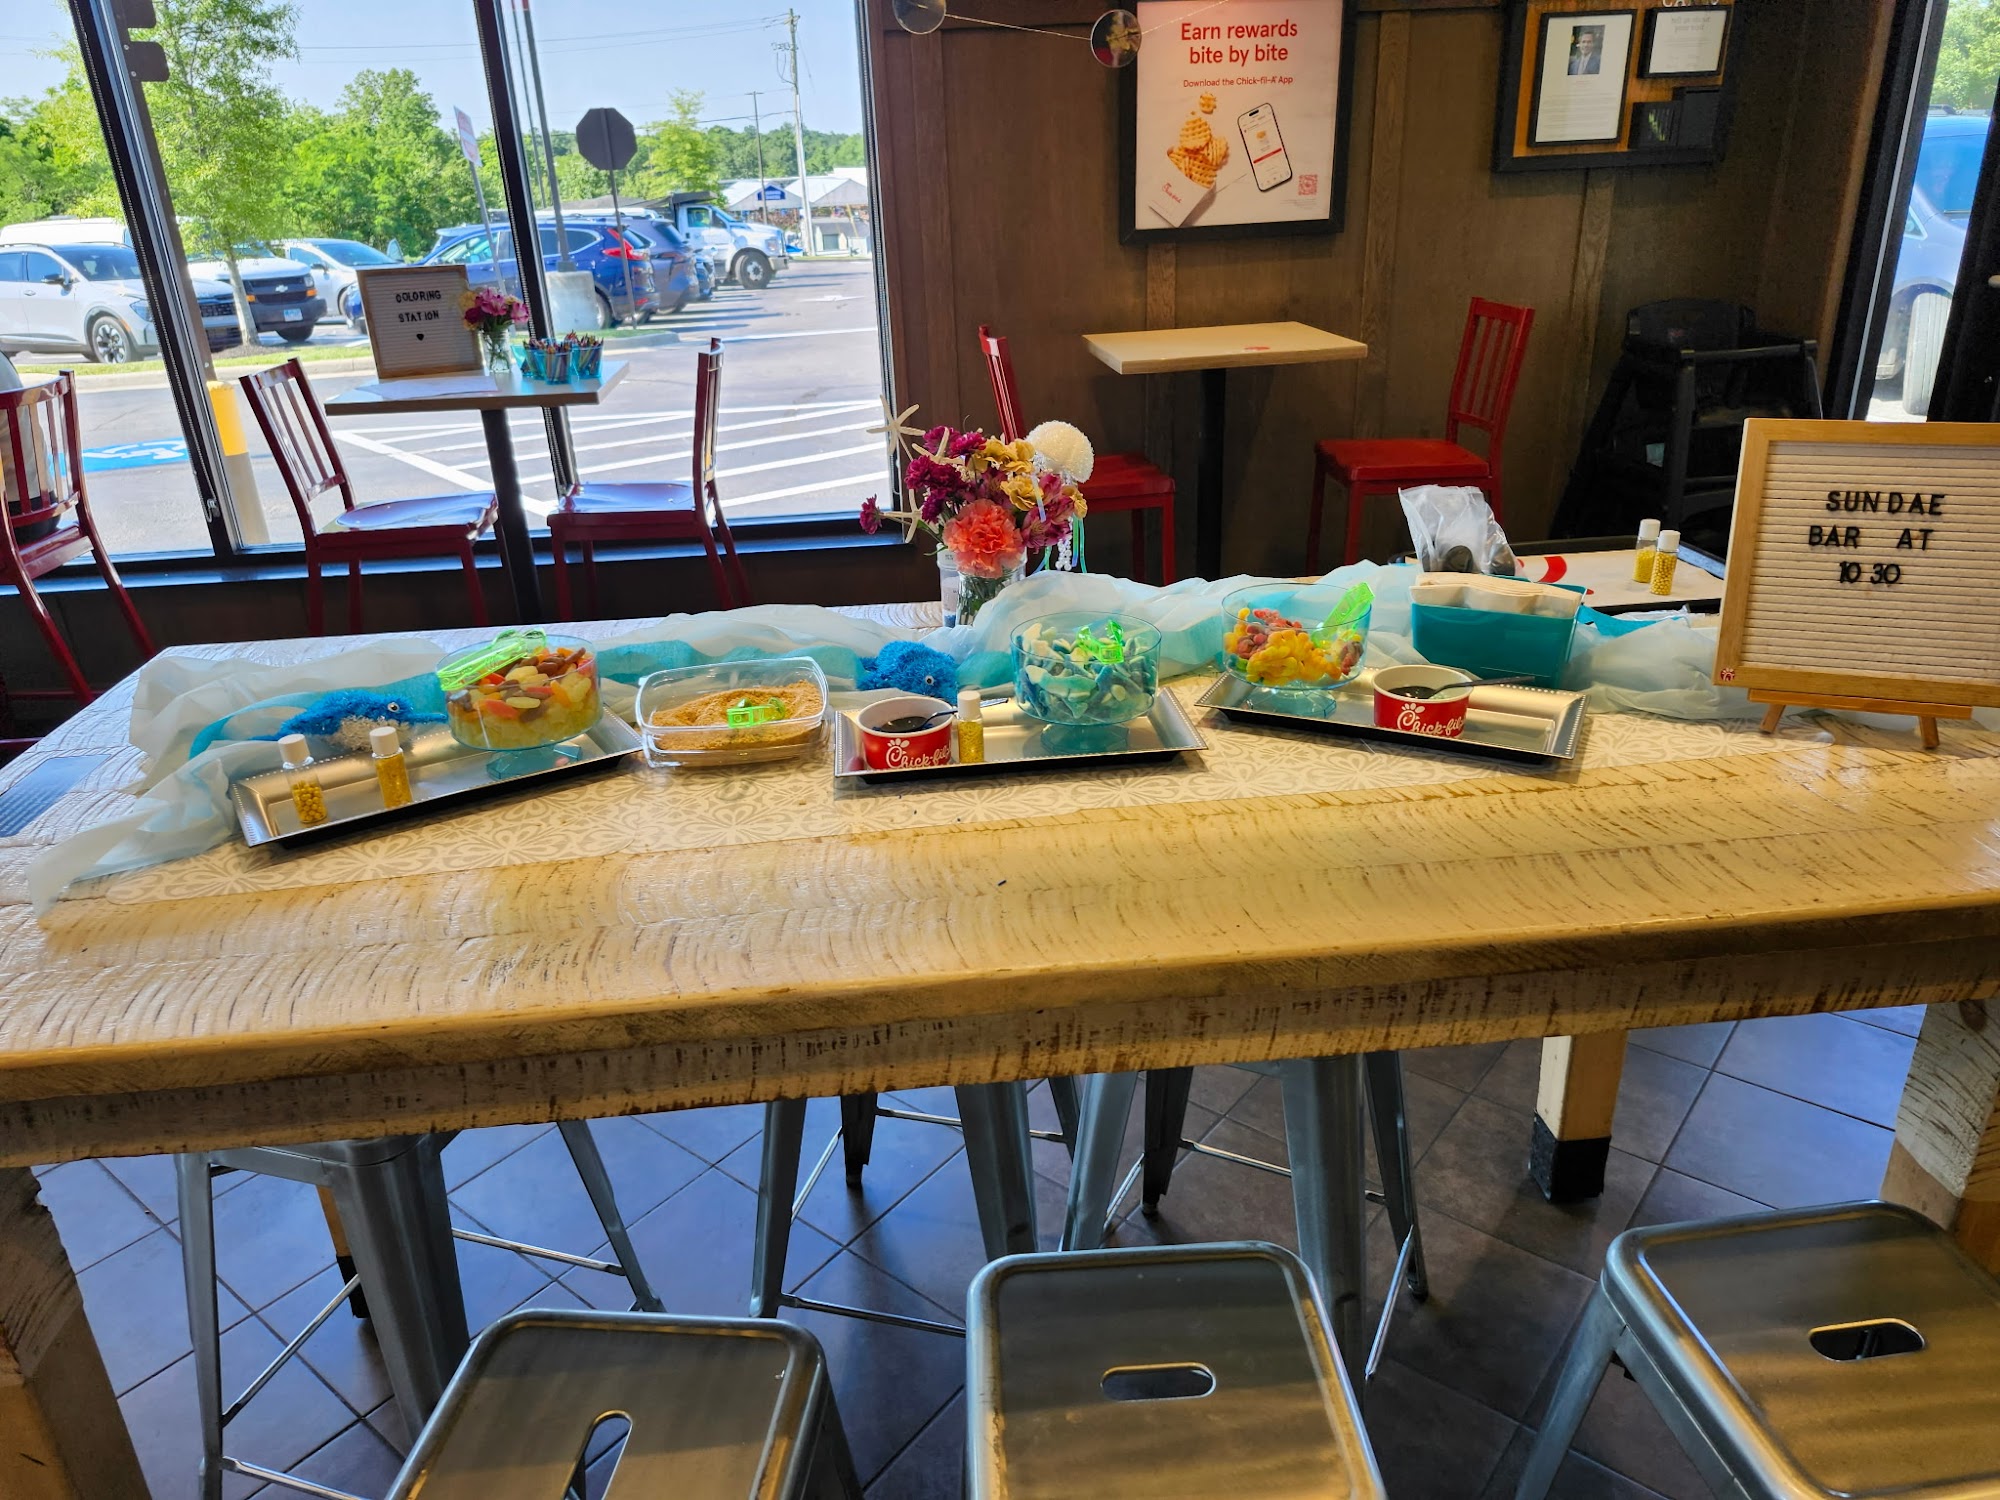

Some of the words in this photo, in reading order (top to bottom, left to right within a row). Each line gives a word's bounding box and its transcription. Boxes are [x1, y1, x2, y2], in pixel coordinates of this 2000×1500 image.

[1181, 23, 1221, 40] Earn
[1227, 19, 1298, 39] rewards
[1190, 46, 1223, 64] bite
[1229, 45, 1249, 67] by
[1255, 43, 1288, 62] bite
[1183, 79, 1220, 88] Download
[1222, 78, 1234, 86] the
[1278, 75, 1294, 85] App
[395, 290, 442, 303] COLORING
[398, 310, 440, 322] STATION
[1826, 490, 1946, 515] SUNDAE
[1808, 525, 1860, 548] BAR
[1896, 528, 1934, 550] AT
